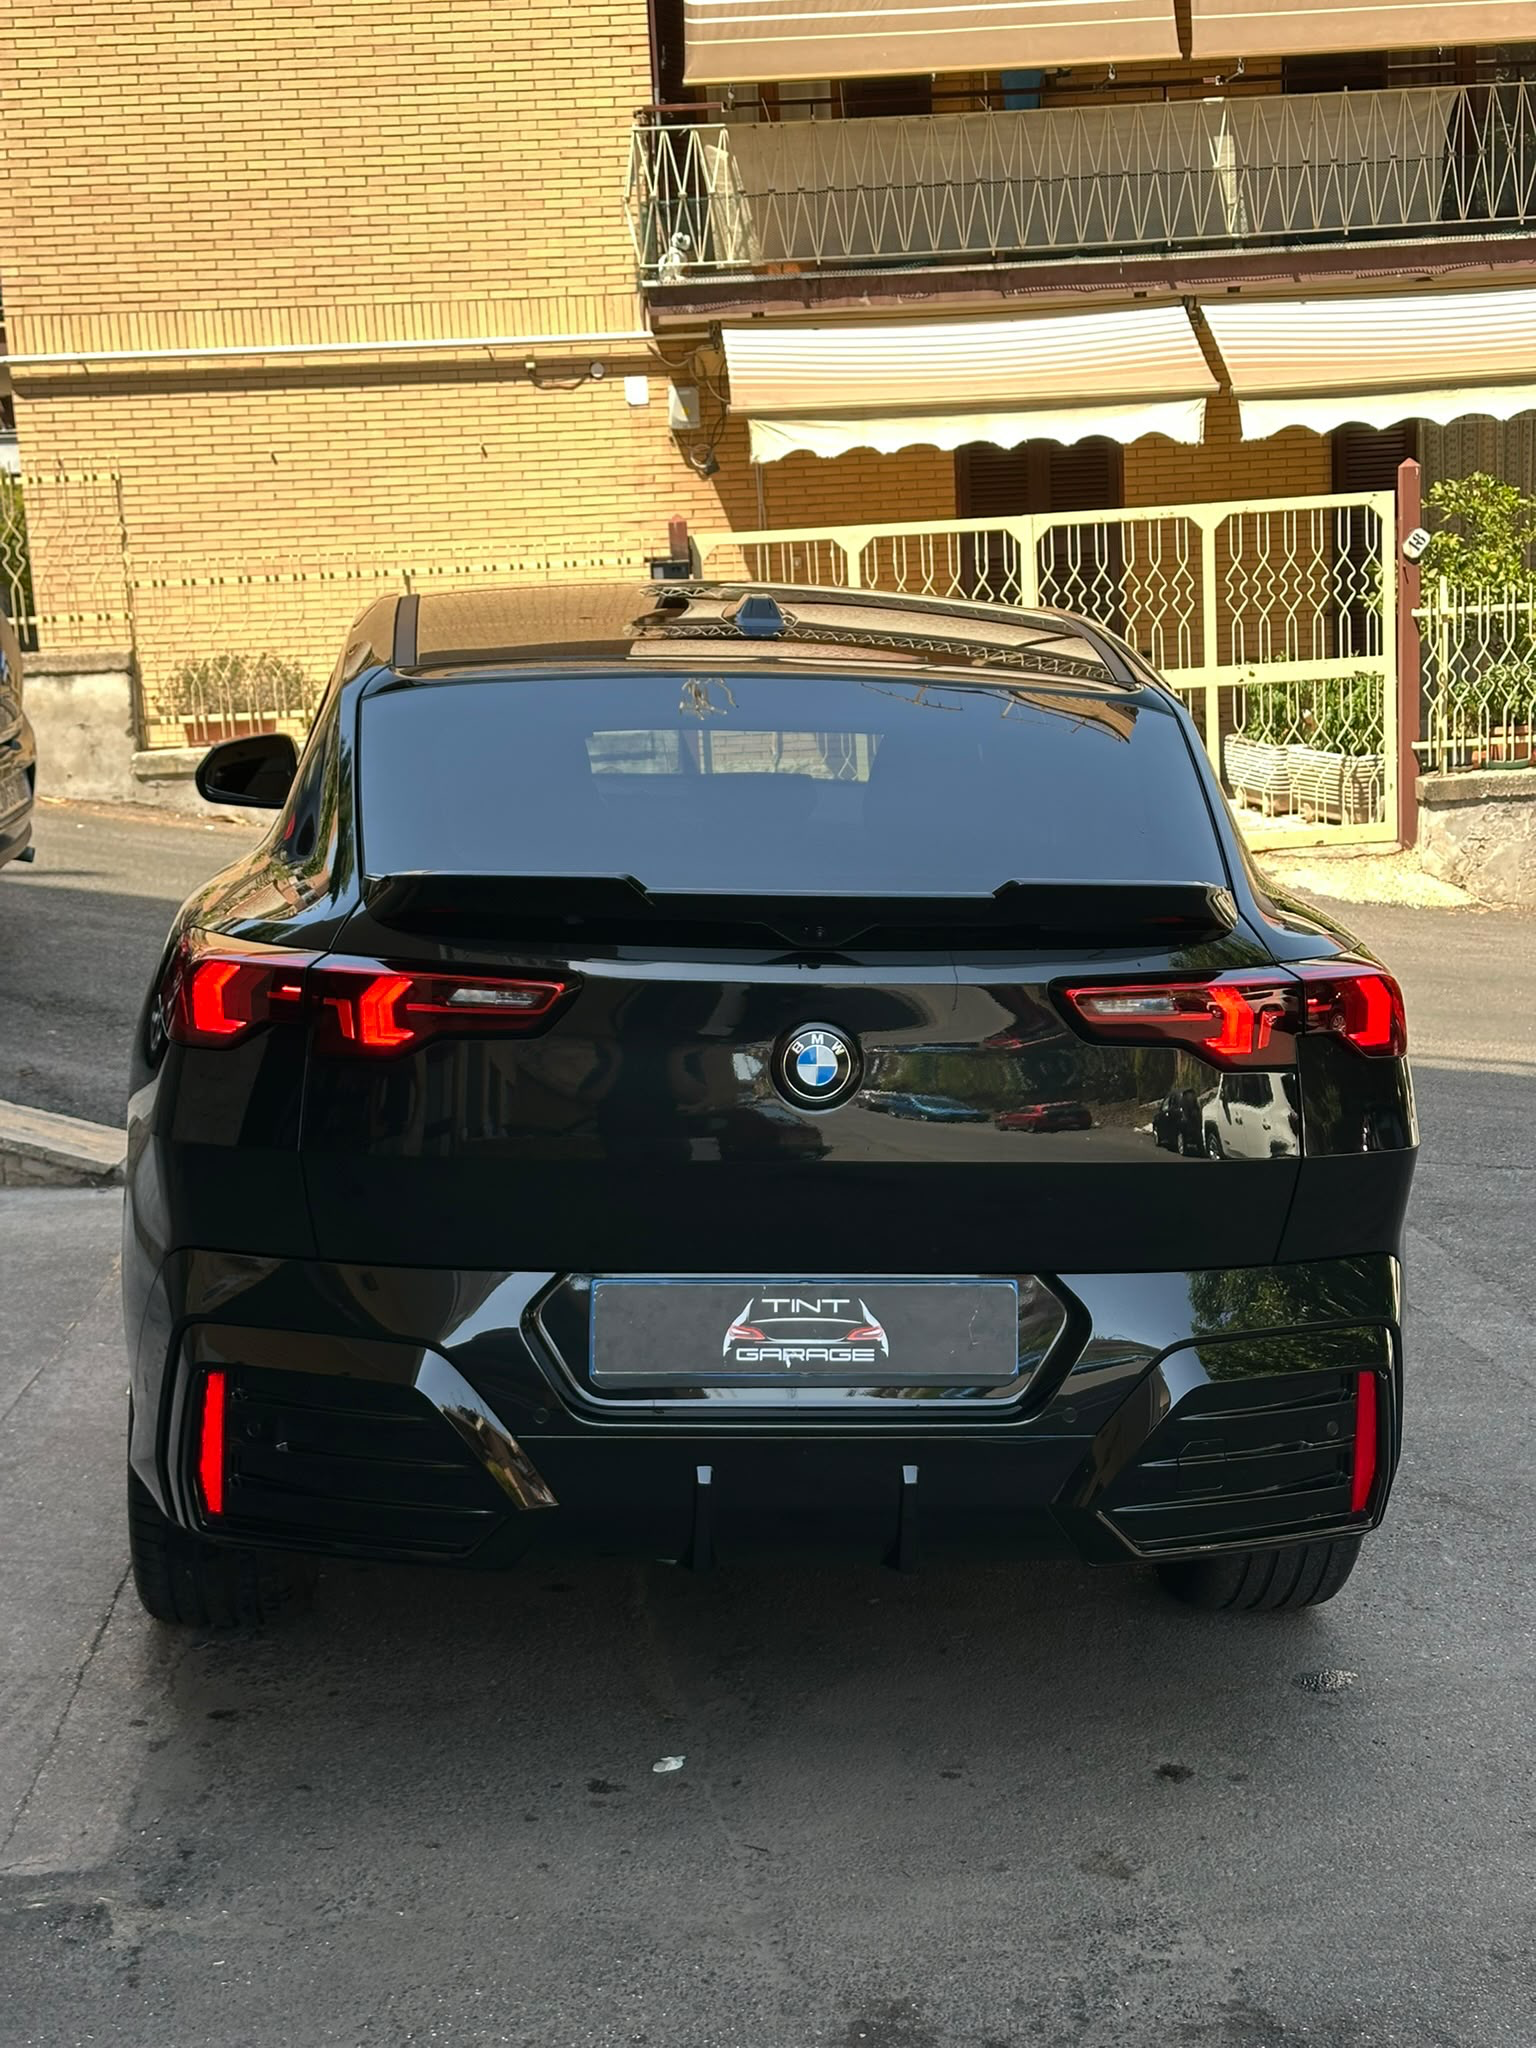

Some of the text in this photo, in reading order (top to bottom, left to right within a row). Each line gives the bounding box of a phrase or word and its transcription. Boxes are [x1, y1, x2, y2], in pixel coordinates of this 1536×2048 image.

[791, 1034, 845, 1055] BMW
[762, 1298, 850, 1313] TINT
[736, 1348, 875, 1362] GARAGE
